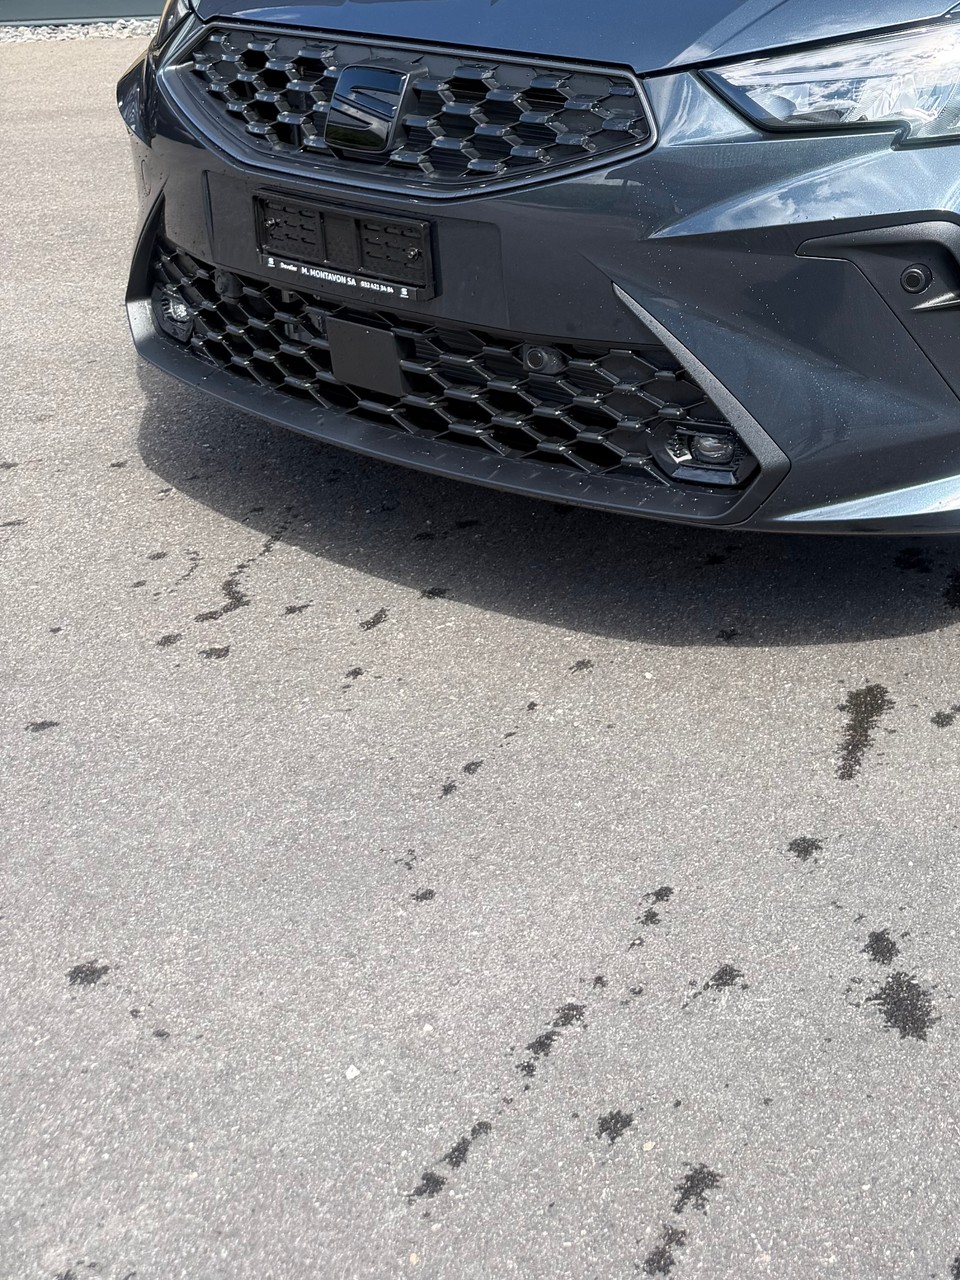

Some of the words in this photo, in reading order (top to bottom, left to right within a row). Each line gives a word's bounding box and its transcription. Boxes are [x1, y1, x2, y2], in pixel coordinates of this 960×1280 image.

[301, 266, 309, 275] M.
[310, 269, 346, 284] MONTAVON
[347, 277, 357, 286] SA
